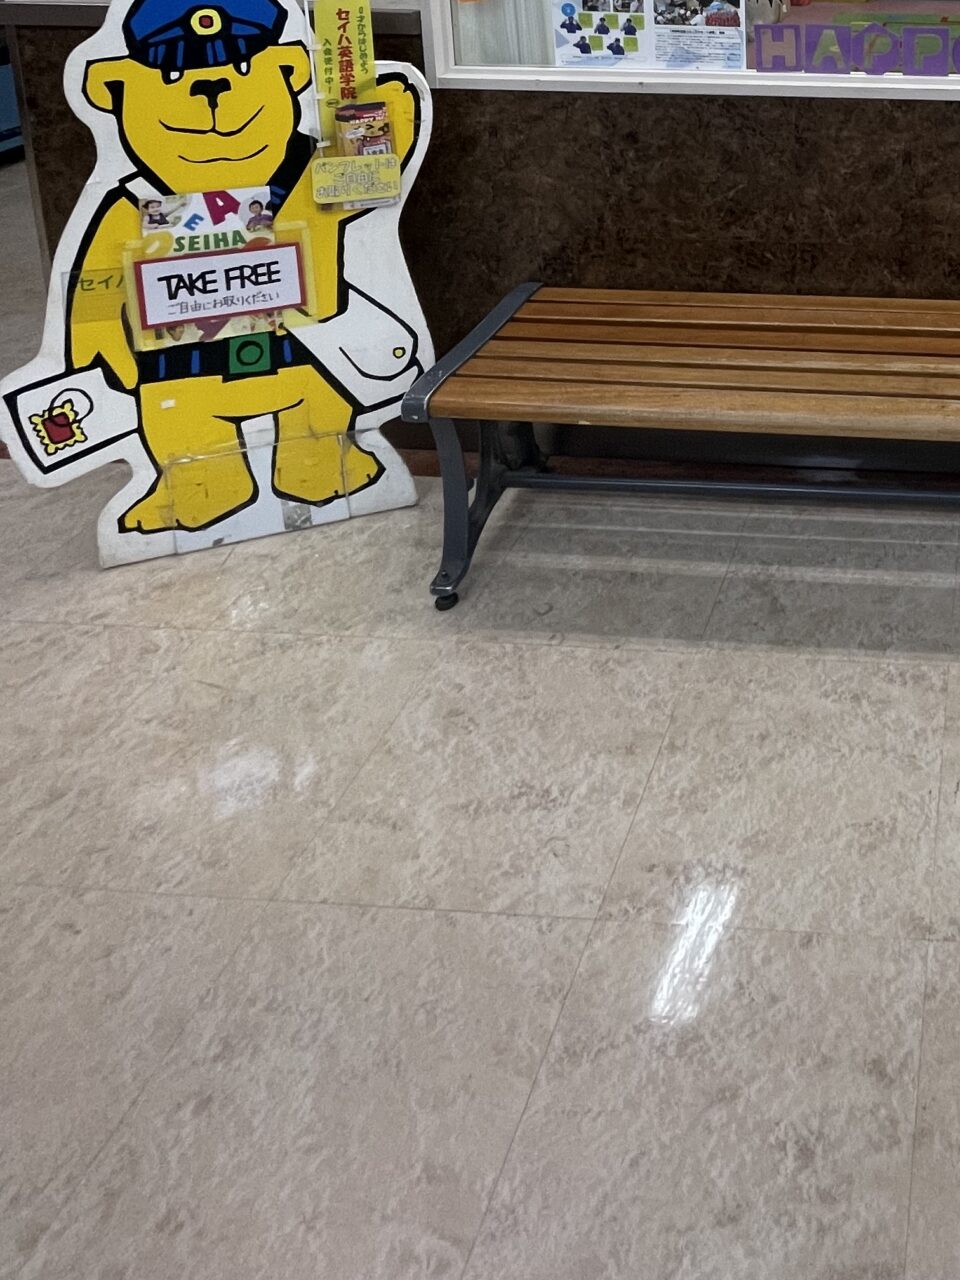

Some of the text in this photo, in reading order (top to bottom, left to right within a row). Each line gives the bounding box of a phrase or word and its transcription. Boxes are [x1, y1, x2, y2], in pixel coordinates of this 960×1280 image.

[335, 8, 358, 101] セイハ英語学院
[173, 230, 247, 253] SEIHA
[157, 260, 282, 301] TAKE FREE
[167, 290, 280, 316] ご自由にお取りください
